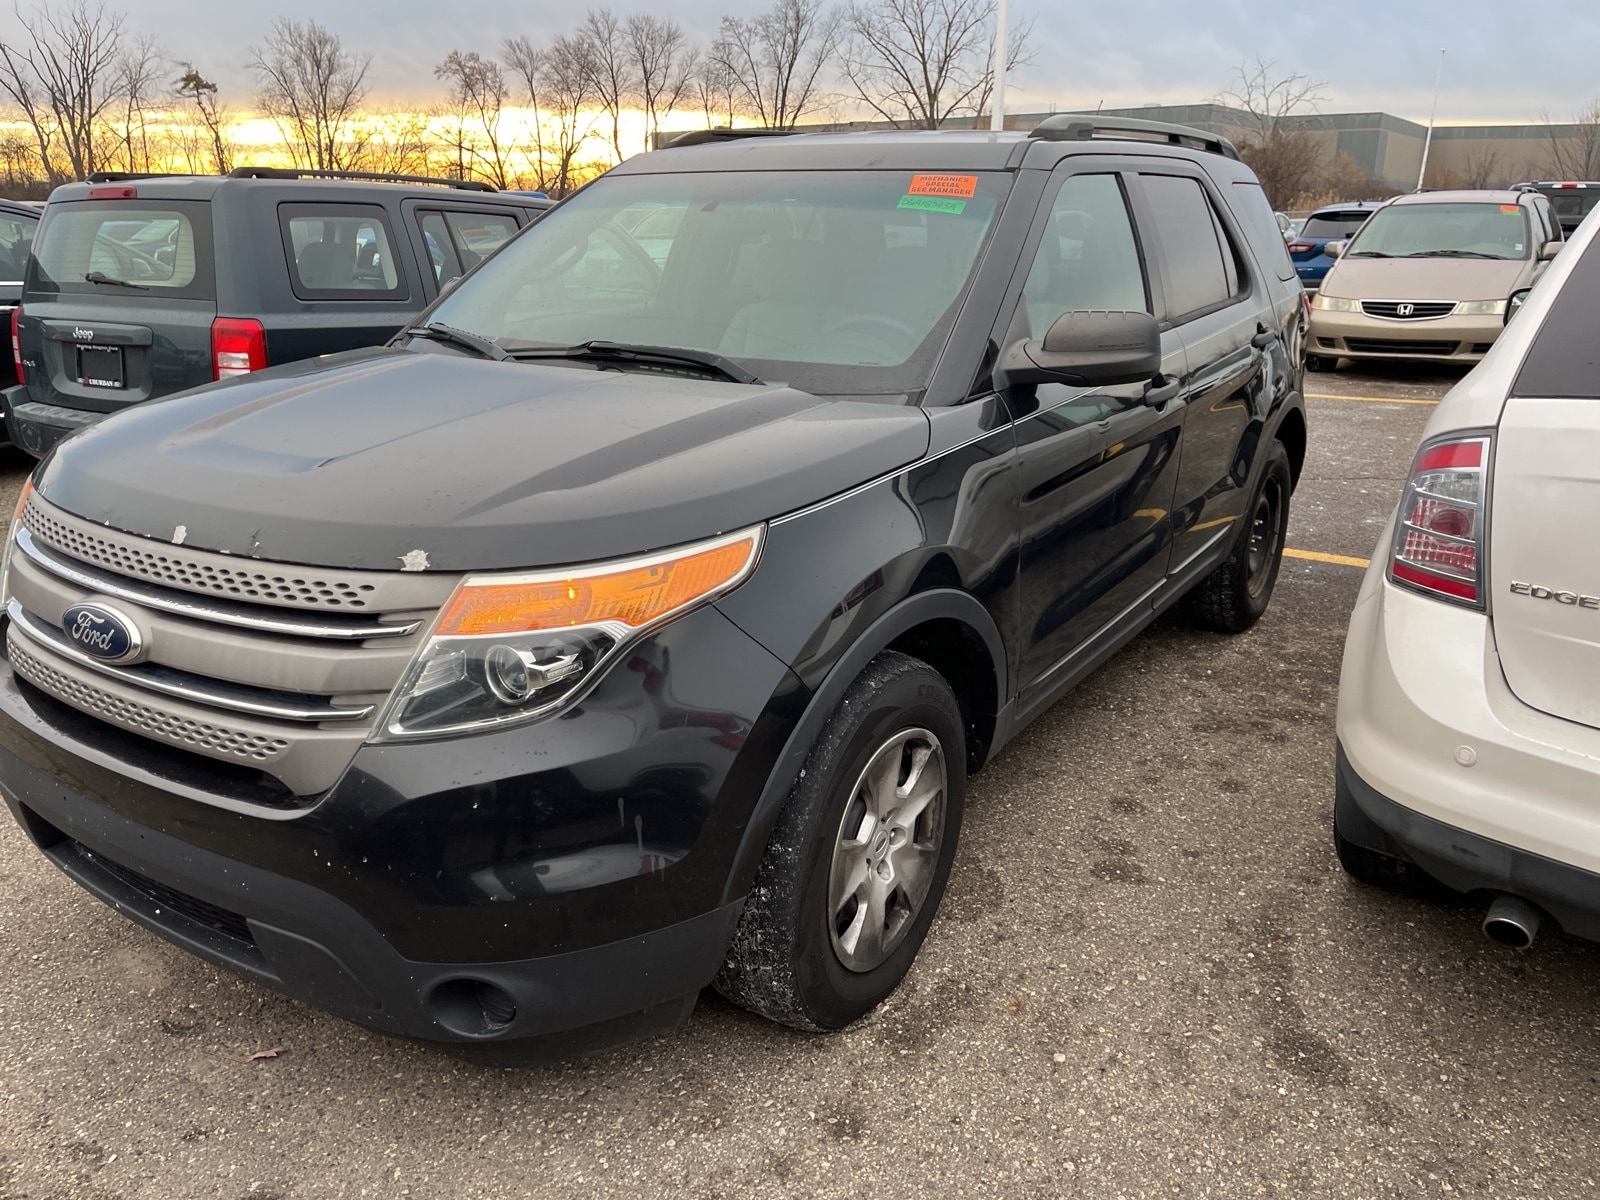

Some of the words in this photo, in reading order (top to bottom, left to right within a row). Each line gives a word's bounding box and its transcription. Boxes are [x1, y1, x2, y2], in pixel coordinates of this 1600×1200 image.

[928, 187, 971, 195] MANAGER
[73, 327, 94, 341] Jeep
[1510, 580, 1600, 610] EDGE
[72, 611, 115, 650] Ford
